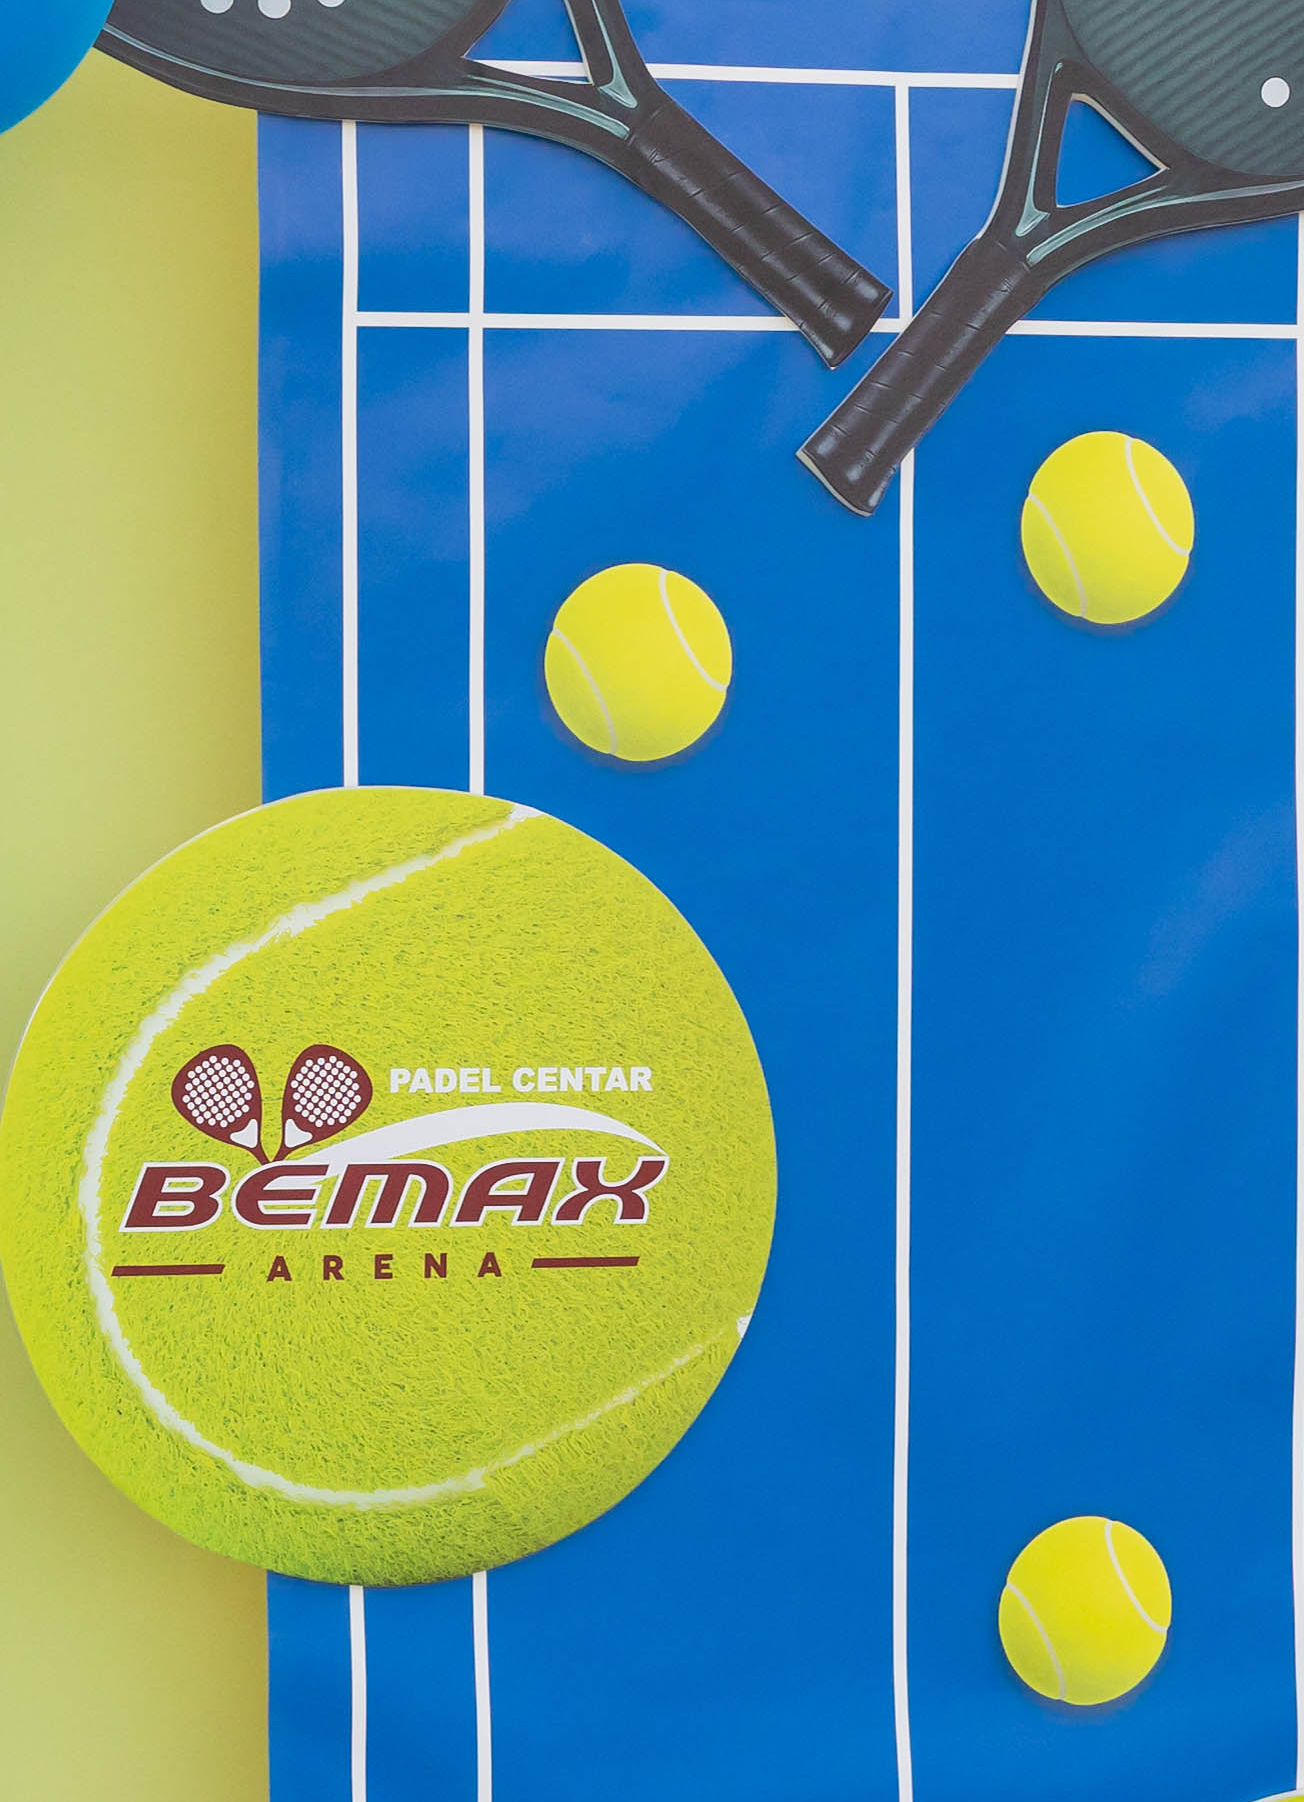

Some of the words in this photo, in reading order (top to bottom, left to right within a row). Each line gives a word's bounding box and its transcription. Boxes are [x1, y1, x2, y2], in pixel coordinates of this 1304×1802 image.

[389, 1067, 502, 1094] PADEL
[511, 1065, 653, 1093] CENTAR
[118, 1156, 671, 1233] BEMAX
[266, 1251, 503, 1282] ARENA
